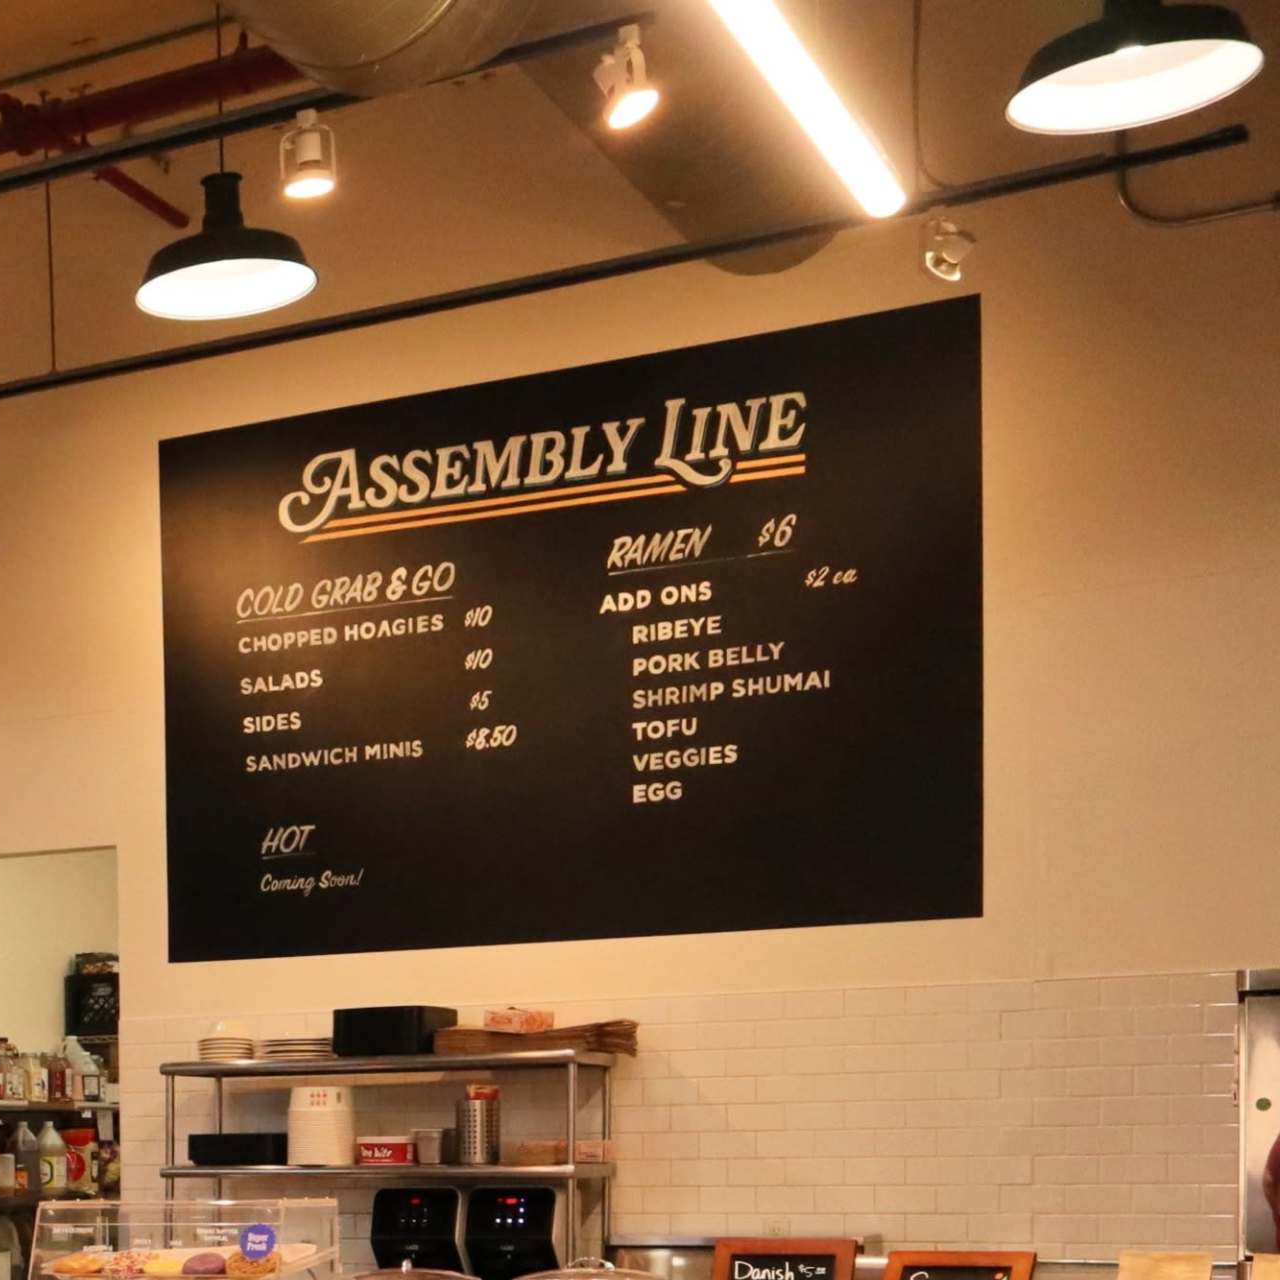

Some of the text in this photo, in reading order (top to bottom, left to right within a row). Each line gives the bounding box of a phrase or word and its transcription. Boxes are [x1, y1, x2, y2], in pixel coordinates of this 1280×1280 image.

[278, 391, 807, 533] ASSEMBLY LINE
[607, 513, 797, 570] RAMEN $6
[236, 561, 456, 618] COLD GRAB & GO
[804, 566, 829, 588] $2
[599, 581, 712, 614] ADD ONS
[238, 606, 493, 654] CHOPPED HOAGIES $10
[632, 615, 722, 644] RIBEYE
[240, 648, 493, 695] SALADS $10
[632, 641, 785, 676] PORK BELLY
[632, 669, 831, 709] SHRIMP SHUMAI
[243, 690, 492, 734] SIDES $5
[632, 717, 698, 741] TOFU
[245, 724, 518, 773] SANDWICH MINIS $8.50
[632, 744, 739, 772] VEGGIES
[632, 781, 683, 803] EGG
[260, 825, 316, 855] HOT
[260, 868, 365, 897] Coming Soon!
[734, 1260, 794, 1280] Danish
